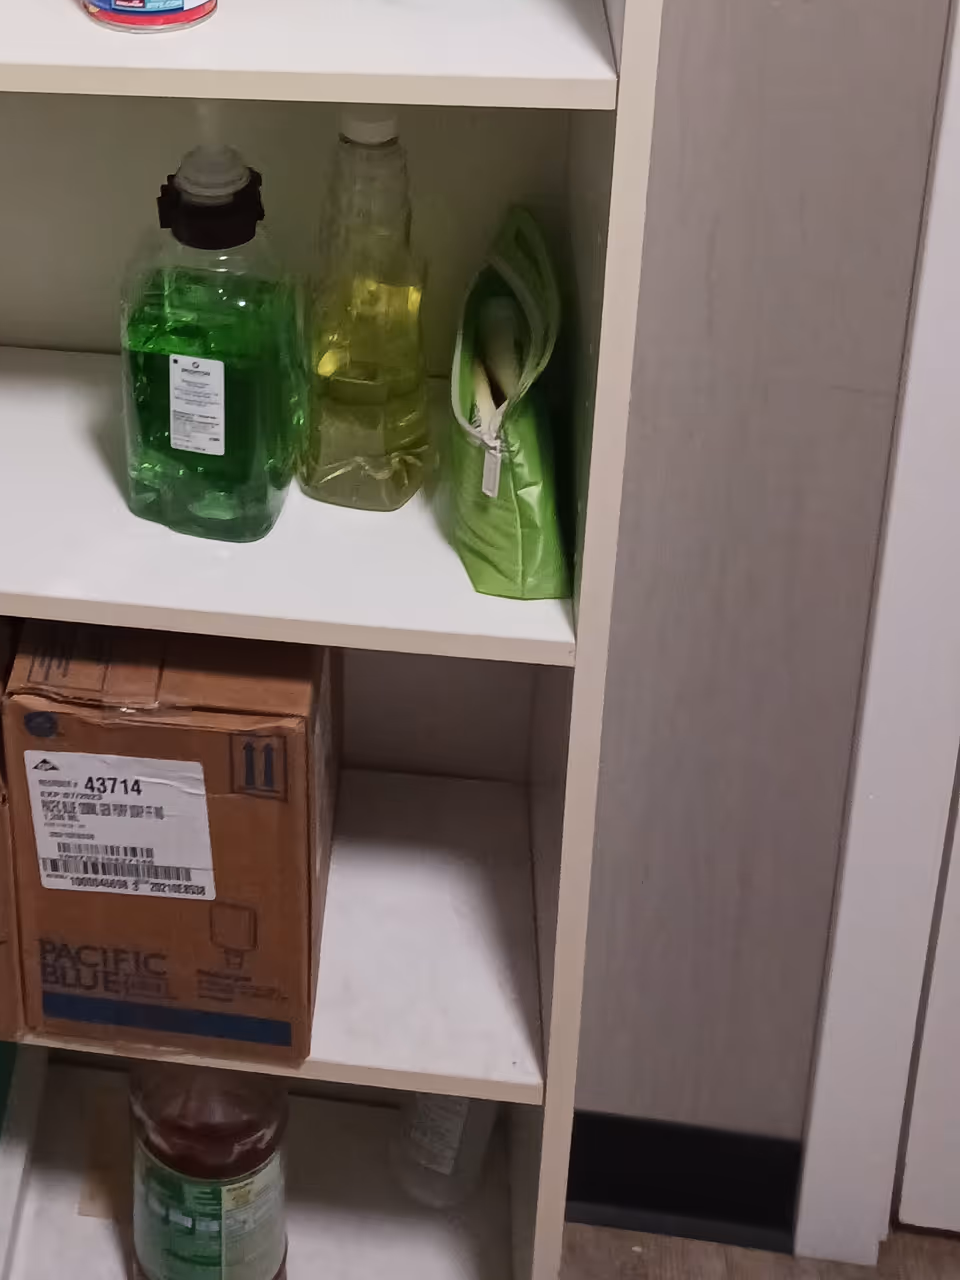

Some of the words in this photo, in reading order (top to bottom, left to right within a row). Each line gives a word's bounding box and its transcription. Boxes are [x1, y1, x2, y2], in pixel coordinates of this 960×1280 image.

[84, 776, 142, 796] 43714
[40, 938, 167, 976] PACIFIC
[42, 963, 123, 994] BLUE
